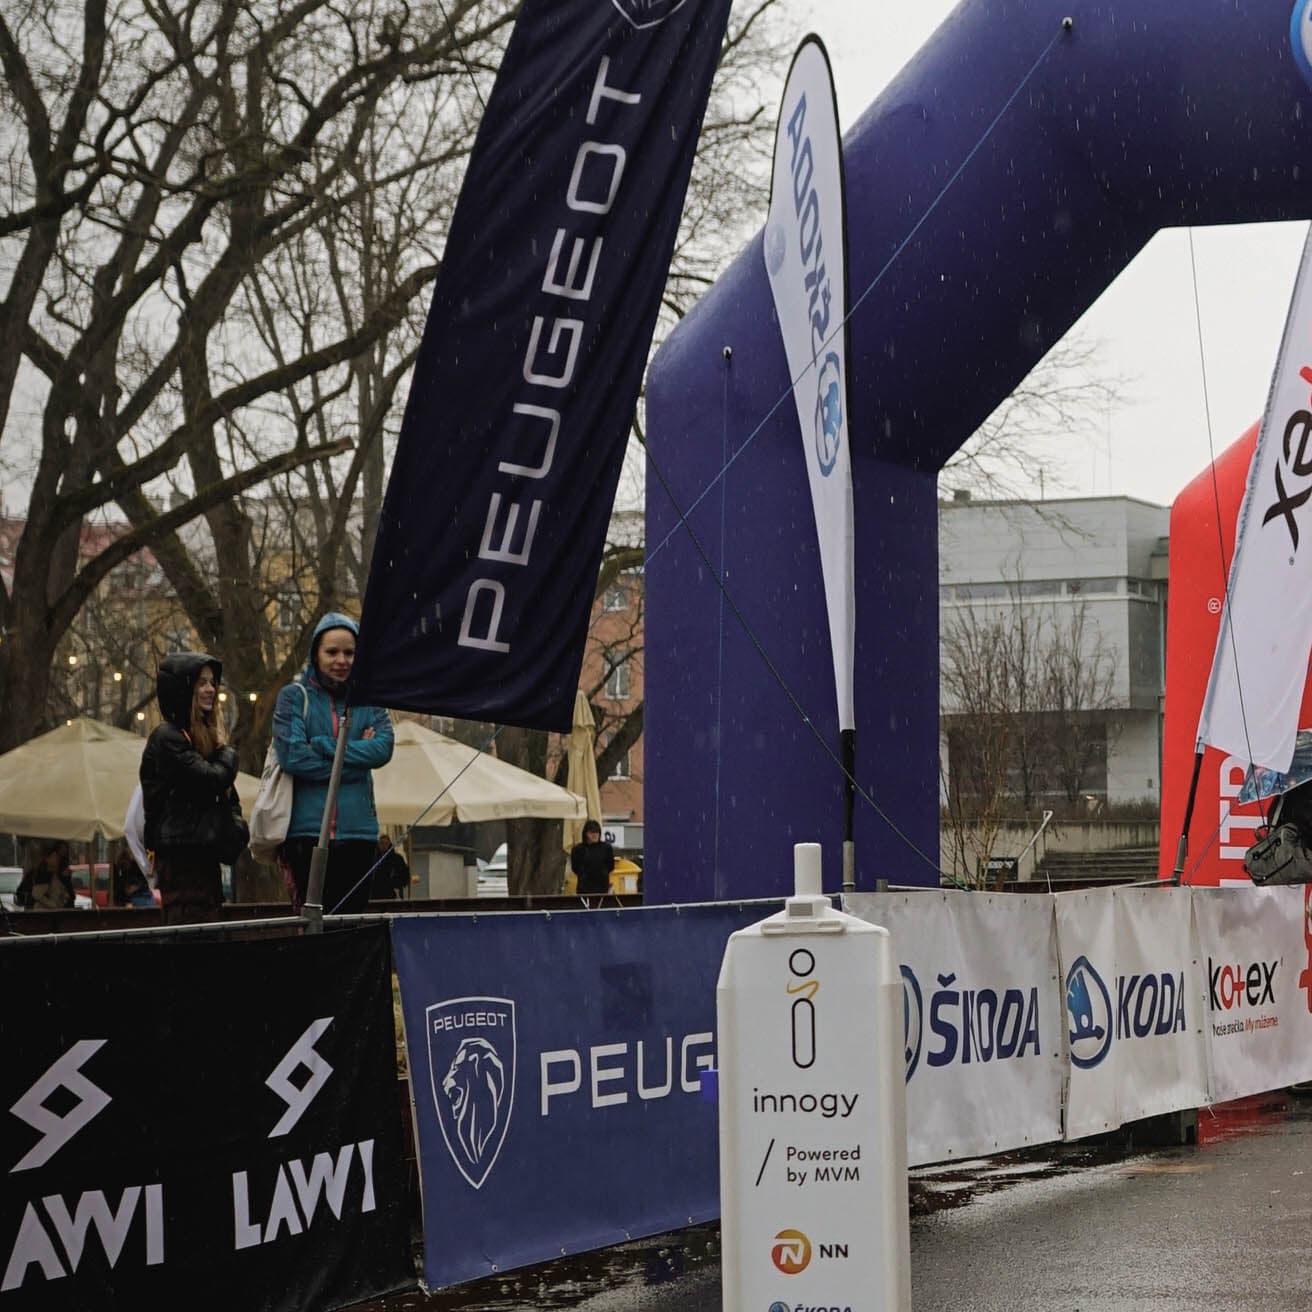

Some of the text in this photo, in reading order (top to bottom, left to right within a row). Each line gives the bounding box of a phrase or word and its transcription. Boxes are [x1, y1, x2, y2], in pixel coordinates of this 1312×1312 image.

[458, 54, 641, 654] PEUGEOT
[927, 973, 1041, 1068] ŠKODA
[1115, 971, 1188, 1041] KODA
[433, 1011, 507, 1033] PEUGEOT
[753, 1087, 859, 1118] innogy
[786, 1145, 861, 1161] Powered
[786, 1167, 860, 1186] by MVM
[233, 1139, 376, 1250] LAWI
[819, 1244, 849, 1258] NN
